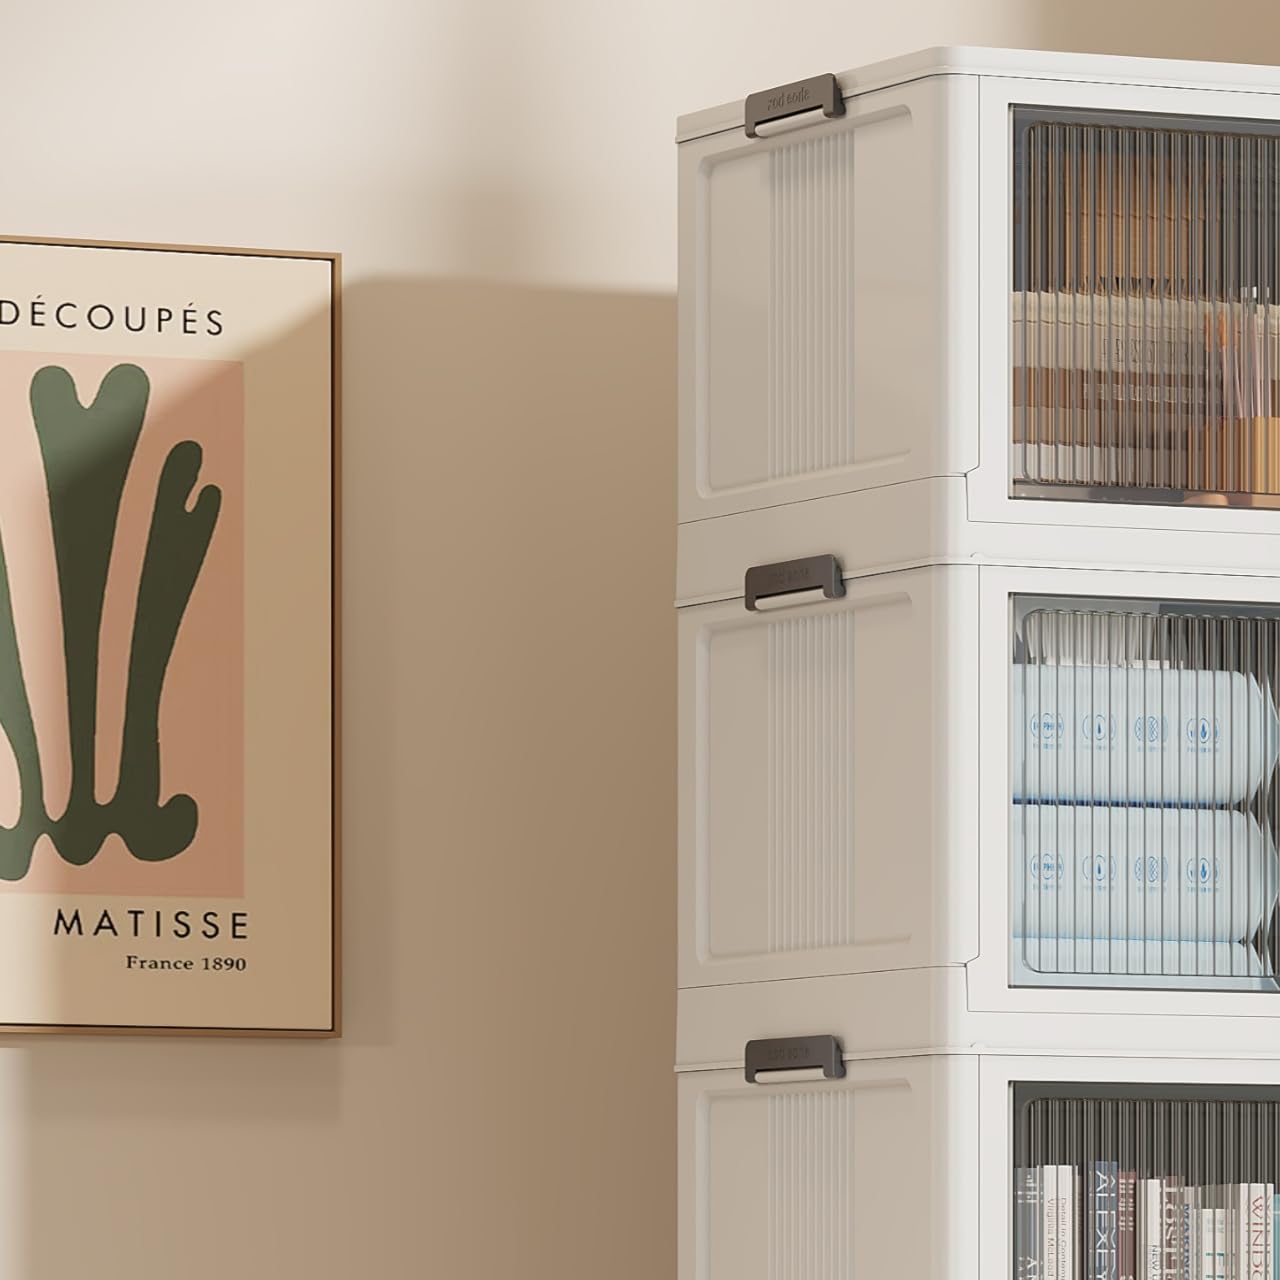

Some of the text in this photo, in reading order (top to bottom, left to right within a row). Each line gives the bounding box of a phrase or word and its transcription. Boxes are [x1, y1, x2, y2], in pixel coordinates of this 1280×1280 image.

[0, 294, 223, 336] DÉCOUPÉS
[53, 908, 248, 939] MATISSE
[126, 955, 247, 972] France 1890
